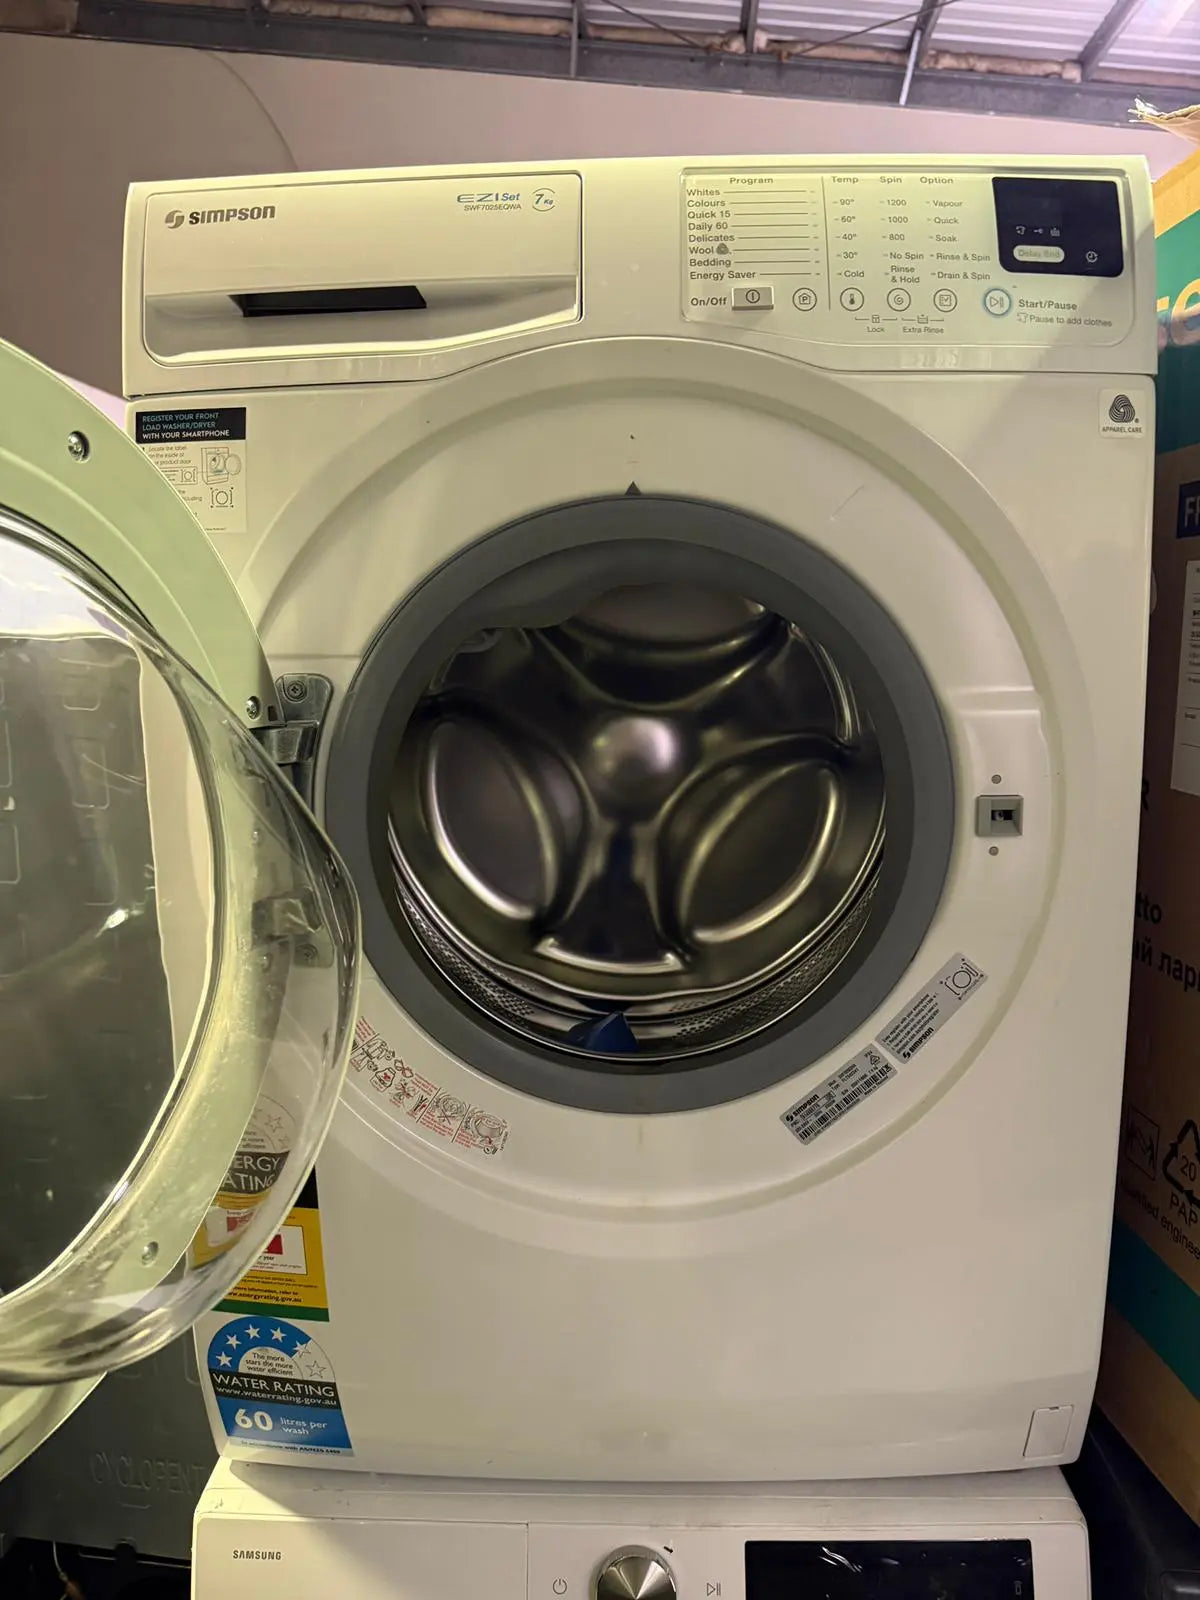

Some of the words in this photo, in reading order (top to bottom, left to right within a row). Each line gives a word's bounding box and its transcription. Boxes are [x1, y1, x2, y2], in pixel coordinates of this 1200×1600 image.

[730, 177, 773, 185] Program
[687, 200, 726, 208] Colours
[933, 200, 963, 208] Vapour
[188, 206, 276, 225] SIMPSON
[688, 211, 716, 219] Quick
[720, 210, 731, 218] 15
[888, 216, 908, 224] 1000
[688, 222, 712, 232] Daily
[716, 222, 728, 230] 60
[689, 234, 736, 242] Delicates
[936, 234, 957, 242] Soak
[689, 246, 714, 254] Wool
[890, 252, 902, 260] No
[906, 252, 924, 260] Spin
[971, 254, 990, 262] Spin
[690, 258, 732, 268] Bedding
[890, 265, 915, 273] Rinse
[690, 272, 724, 281] Energy
[728, 271, 756, 279] Saver
[844, 270, 865, 278] Cold
[937, 272, 960, 280] Drain
[963, 272, 969, 280] &
[971, 272, 990, 281] Spin
[900, 276, 920, 284] Hold
[690, 297, 728, 306] On/Off
[1018, 299, 1078, 310] Start/Pause
[1030, 314, 1054, 324] Pause
[1056, 315, 1064, 324] to
[1067, 317, 1082, 325] add
[1084, 318, 1112, 327] clothes
[867, 326, 885, 334] Lock
[902, 326, 921, 334] Extra
[924, 326, 944, 334] Rinse
[142, 414, 174, 422] REGISTER
[175, 413, 194, 422] YOUR
[196, 412, 219, 420] FRONT
[142, 423, 160, 431] LOAD
[162, 422, 216, 430] WASHER/DRYER
[142, 432, 160, 440] WITH
[162, 431, 180, 439] YOUR
[182, 430, 230, 438] SMARTPHONE
[908, 1026, 934, 1053] SIMPSON
[1179, 1154, 1197, 1182] 20
[1170, 1191, 1198, 1228] PAP
[252, 1352, 266, 1360] The
[262, 1360, 274, 1368] the
[268, 1366, 294, 1376] efficient
[212, 1372, 270, 1392] WATER
[274, 1381, 335, 1397] RATING
[216, 1386, 337, 1406] www.waterrating.gov.au
[234, 1408, 273, 1432] 60
[280, 1418, 306, 1427] litres
[310, 1420, 328, 1429] per
[282, 1426, 309, 1435] wash
[232, 1550, 282, 1560] SAMSUNG
